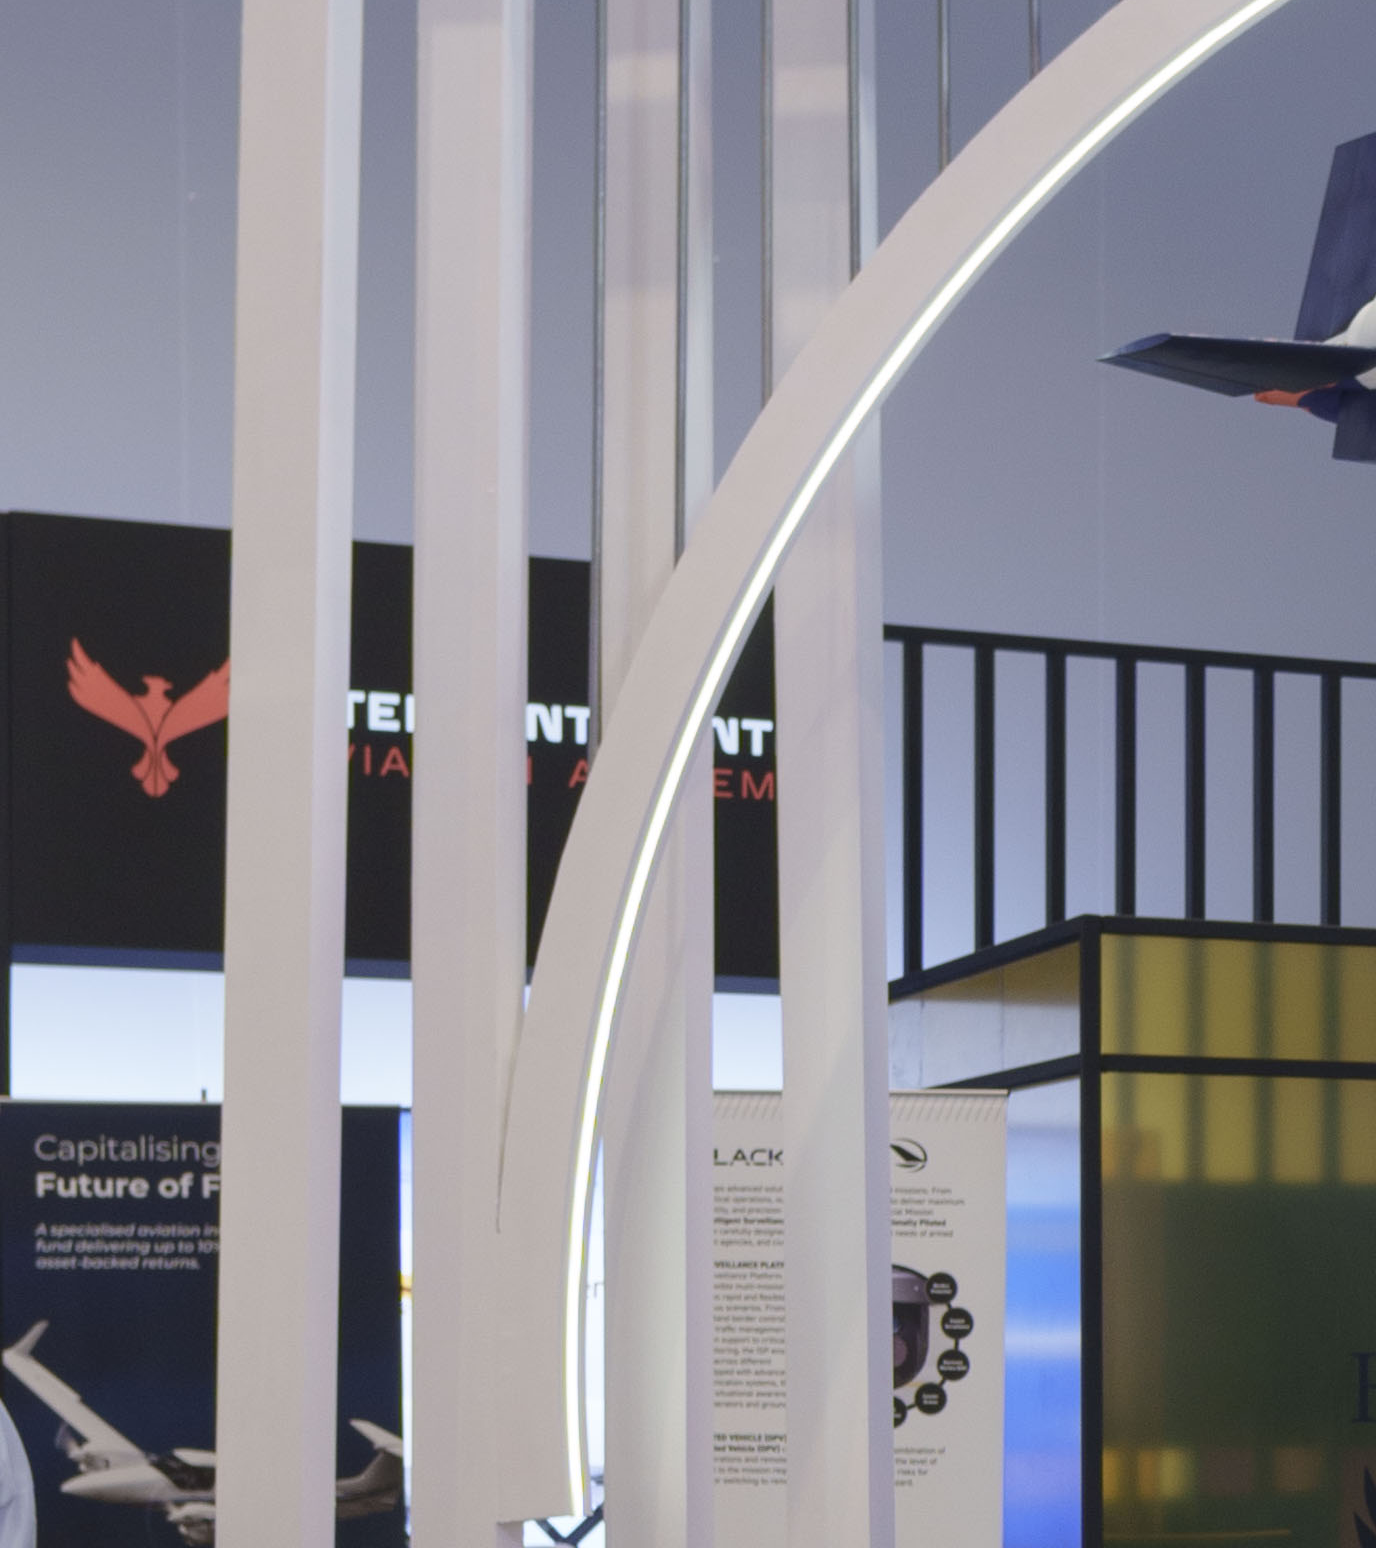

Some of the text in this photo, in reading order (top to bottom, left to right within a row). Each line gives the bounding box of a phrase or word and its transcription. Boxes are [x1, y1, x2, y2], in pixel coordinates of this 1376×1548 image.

[34, 1134, 221, 1168] Capitalising
[36, 1172, 149, 1198] Future
[158, 1172, 194, 1198] of
